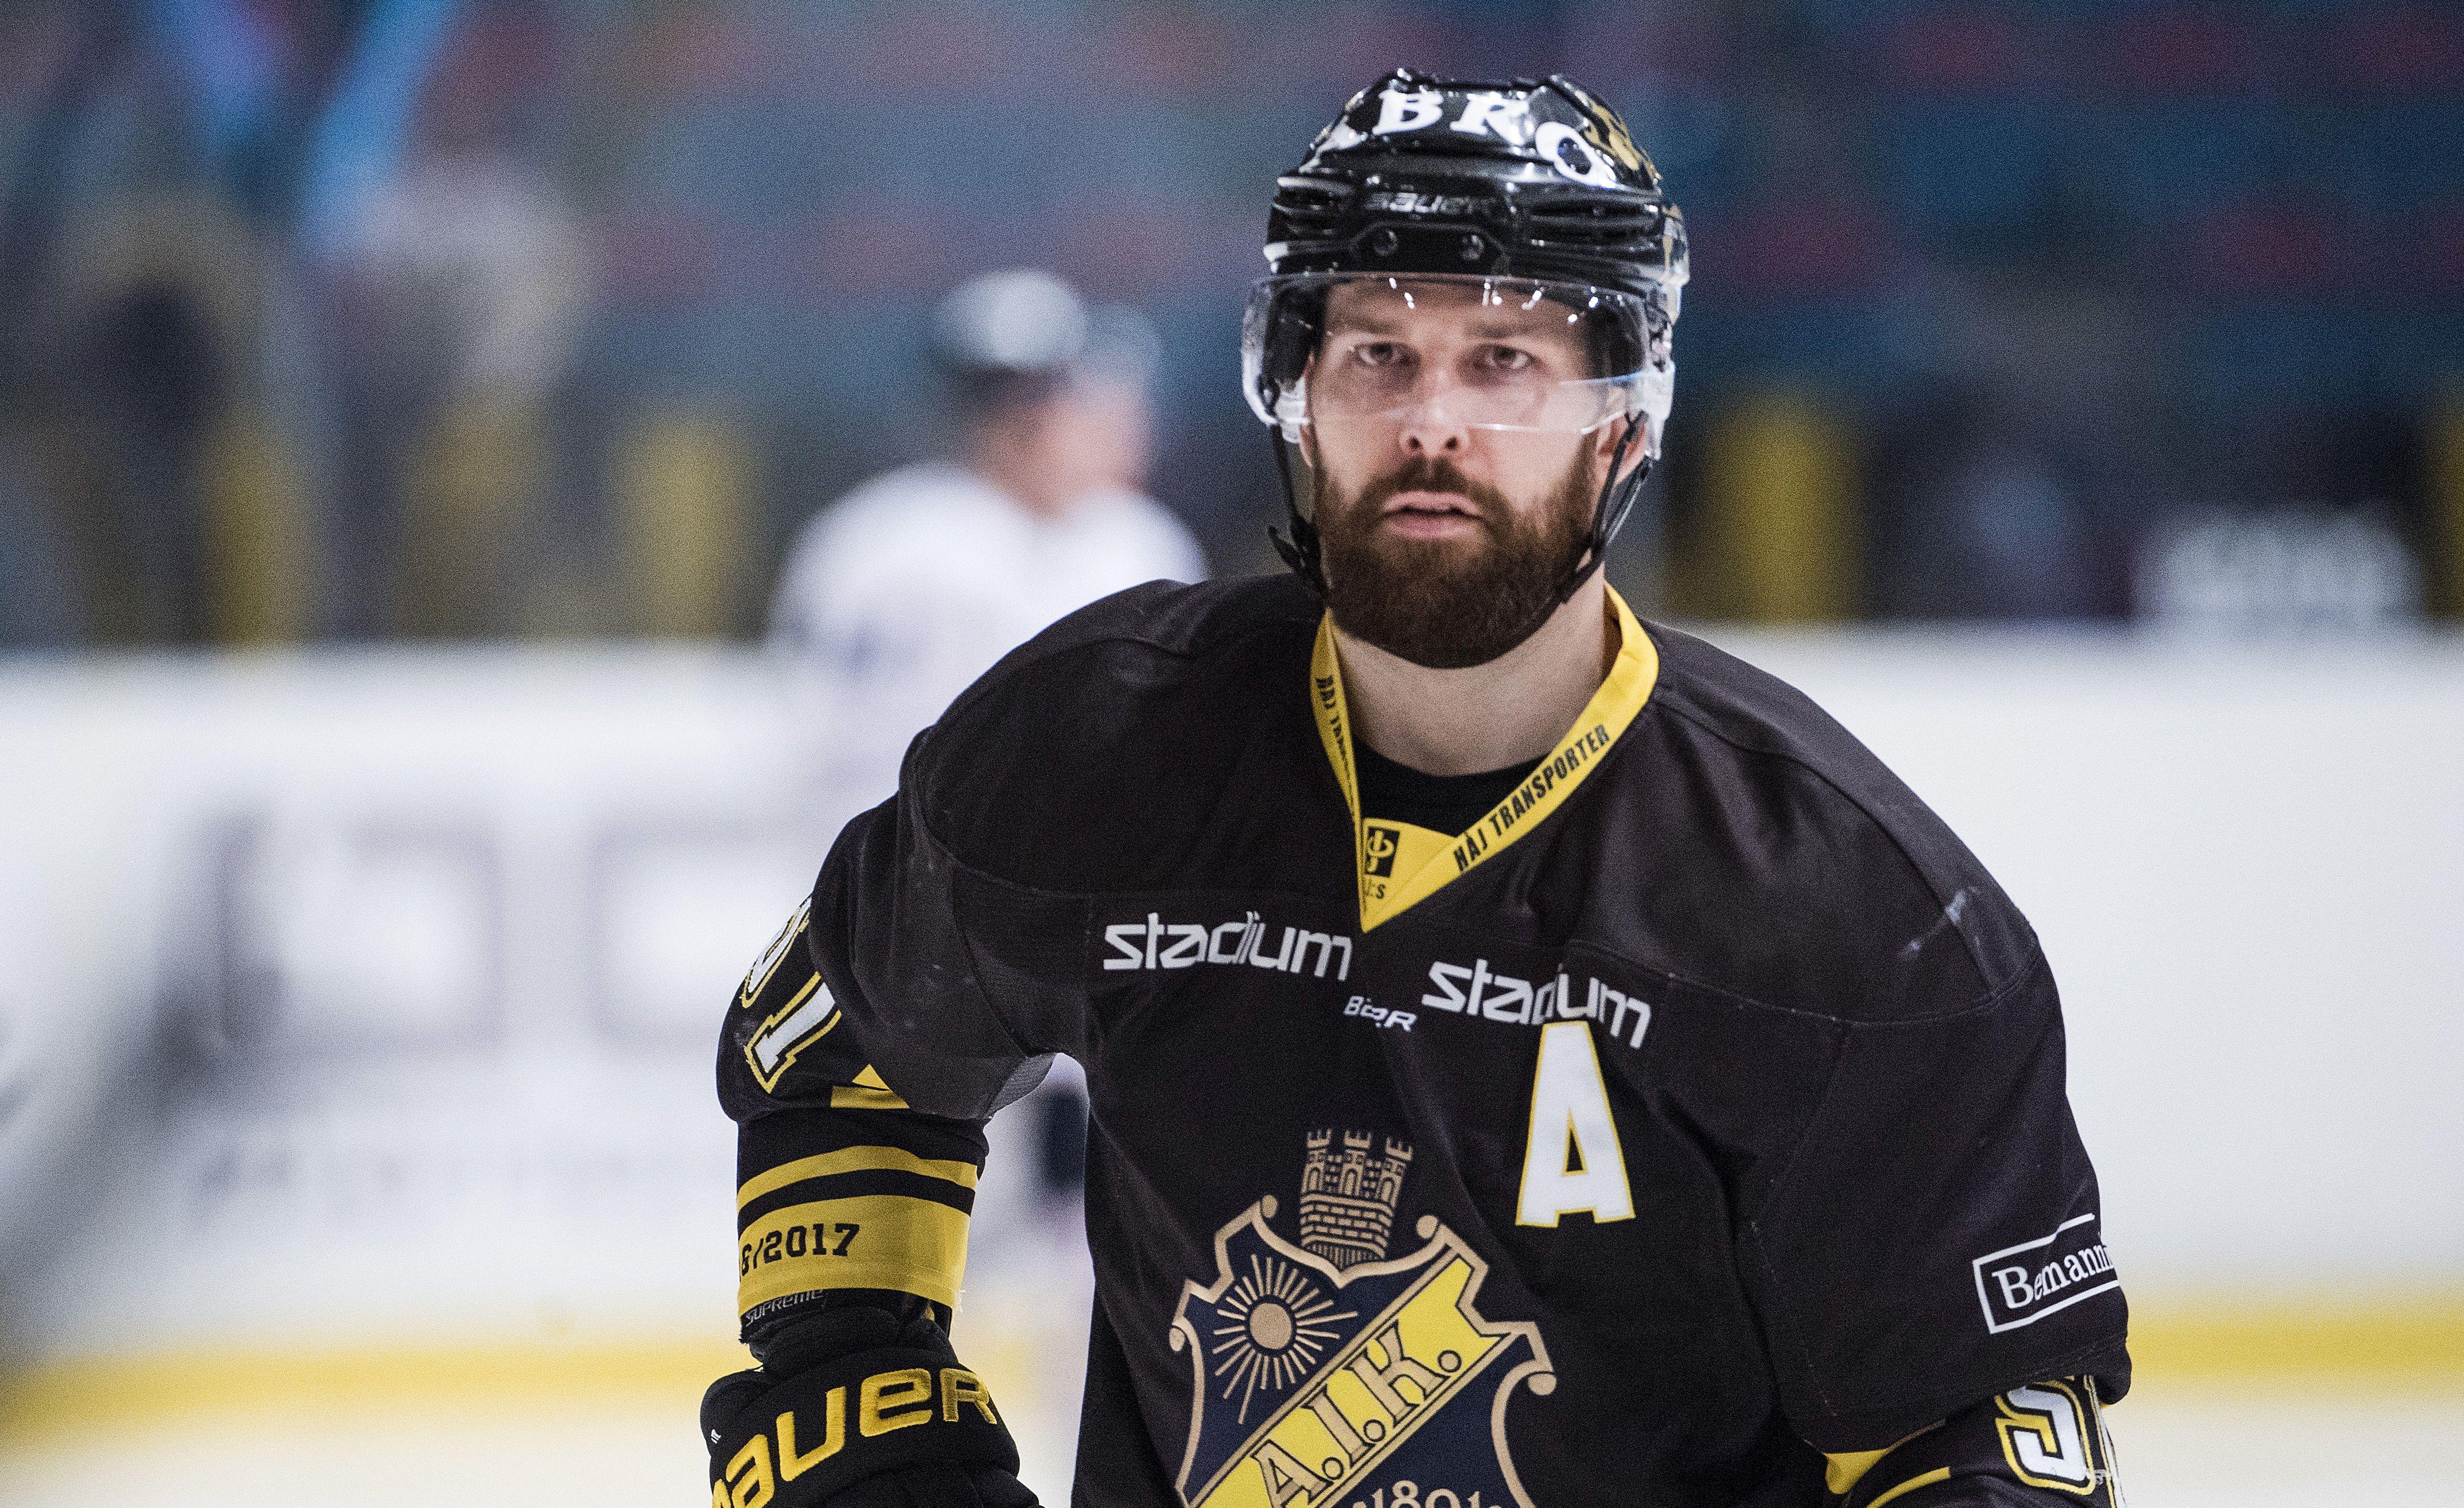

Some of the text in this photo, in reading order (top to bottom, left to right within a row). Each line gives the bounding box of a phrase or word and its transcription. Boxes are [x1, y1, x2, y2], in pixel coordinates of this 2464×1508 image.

[1489, 724, 1610, 836] TRANSPORTER
[1103, 911, 1352, 981] stadium
[1421, 958, 1652, 1049] stadium
[1515, 1020, 1636, 1227] A
